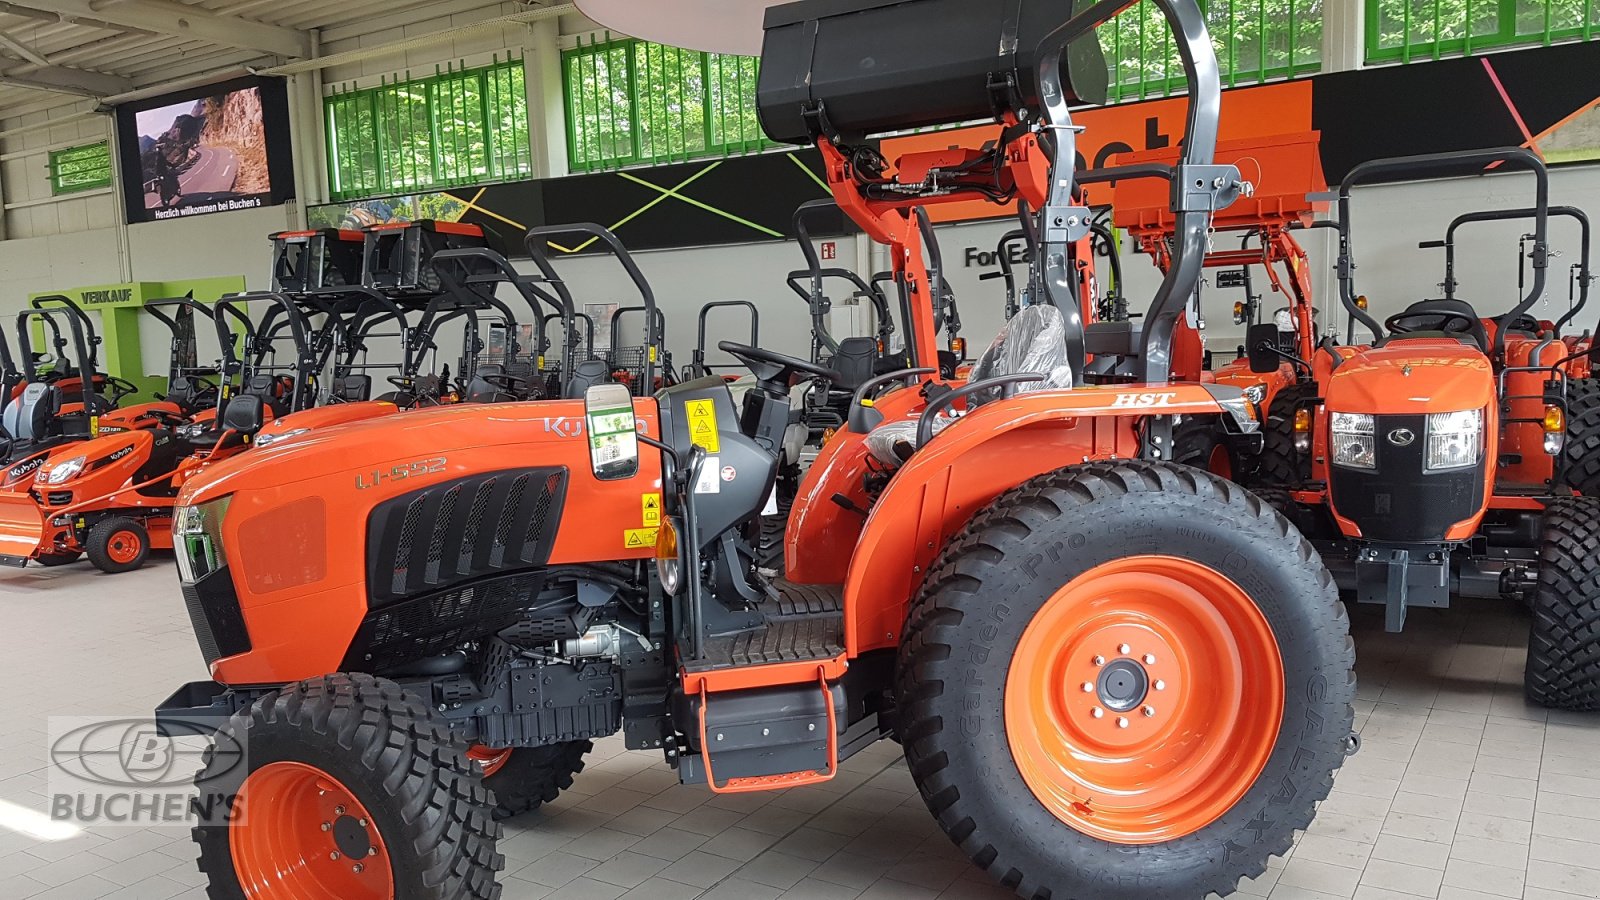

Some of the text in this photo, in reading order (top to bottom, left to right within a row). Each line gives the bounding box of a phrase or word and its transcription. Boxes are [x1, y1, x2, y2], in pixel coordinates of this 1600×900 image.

[154, 208, 180, 219] Herzlich
[180, 203, 217, 216] willkommen
[217, 200, 229, 211] bei
[81, 288, 132, 305] VERKAUF
[1112, 392, 1176, 407] HST
[110, 446, 133, 460] Kubota
[10, 458, 44, 477] Kubota
[355, 457, 447, 489] L1-552
[959, 602, 1010, 738] Garden
[1020, 531, 1086, 580] Pro
[1222, 673, 1329, 868] GALAXY
